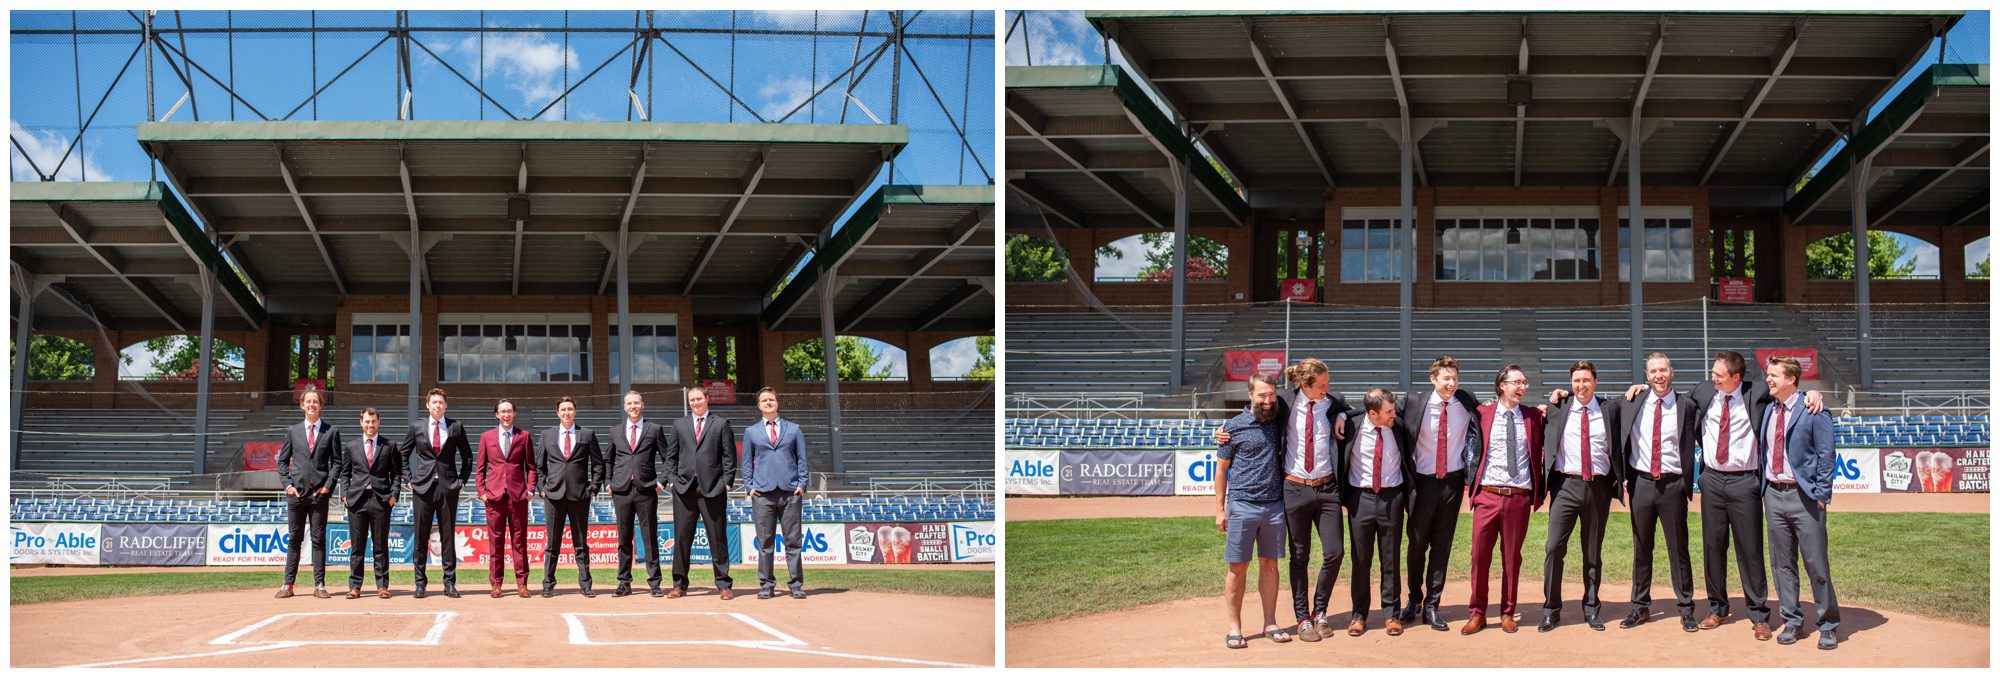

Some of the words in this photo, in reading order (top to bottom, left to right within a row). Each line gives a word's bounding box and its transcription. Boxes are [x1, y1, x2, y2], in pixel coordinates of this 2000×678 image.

[1010, 460, 1054, 477] Able
[1080, 463, 1173, 477] RADCLIFFE
[1959, 481, 1987, 490] BATCH
[120, 536, 205, 549] RADCLIFFE
[966, 531, 995, 546] Pro
[917, 553, 943, 561] BATCH
